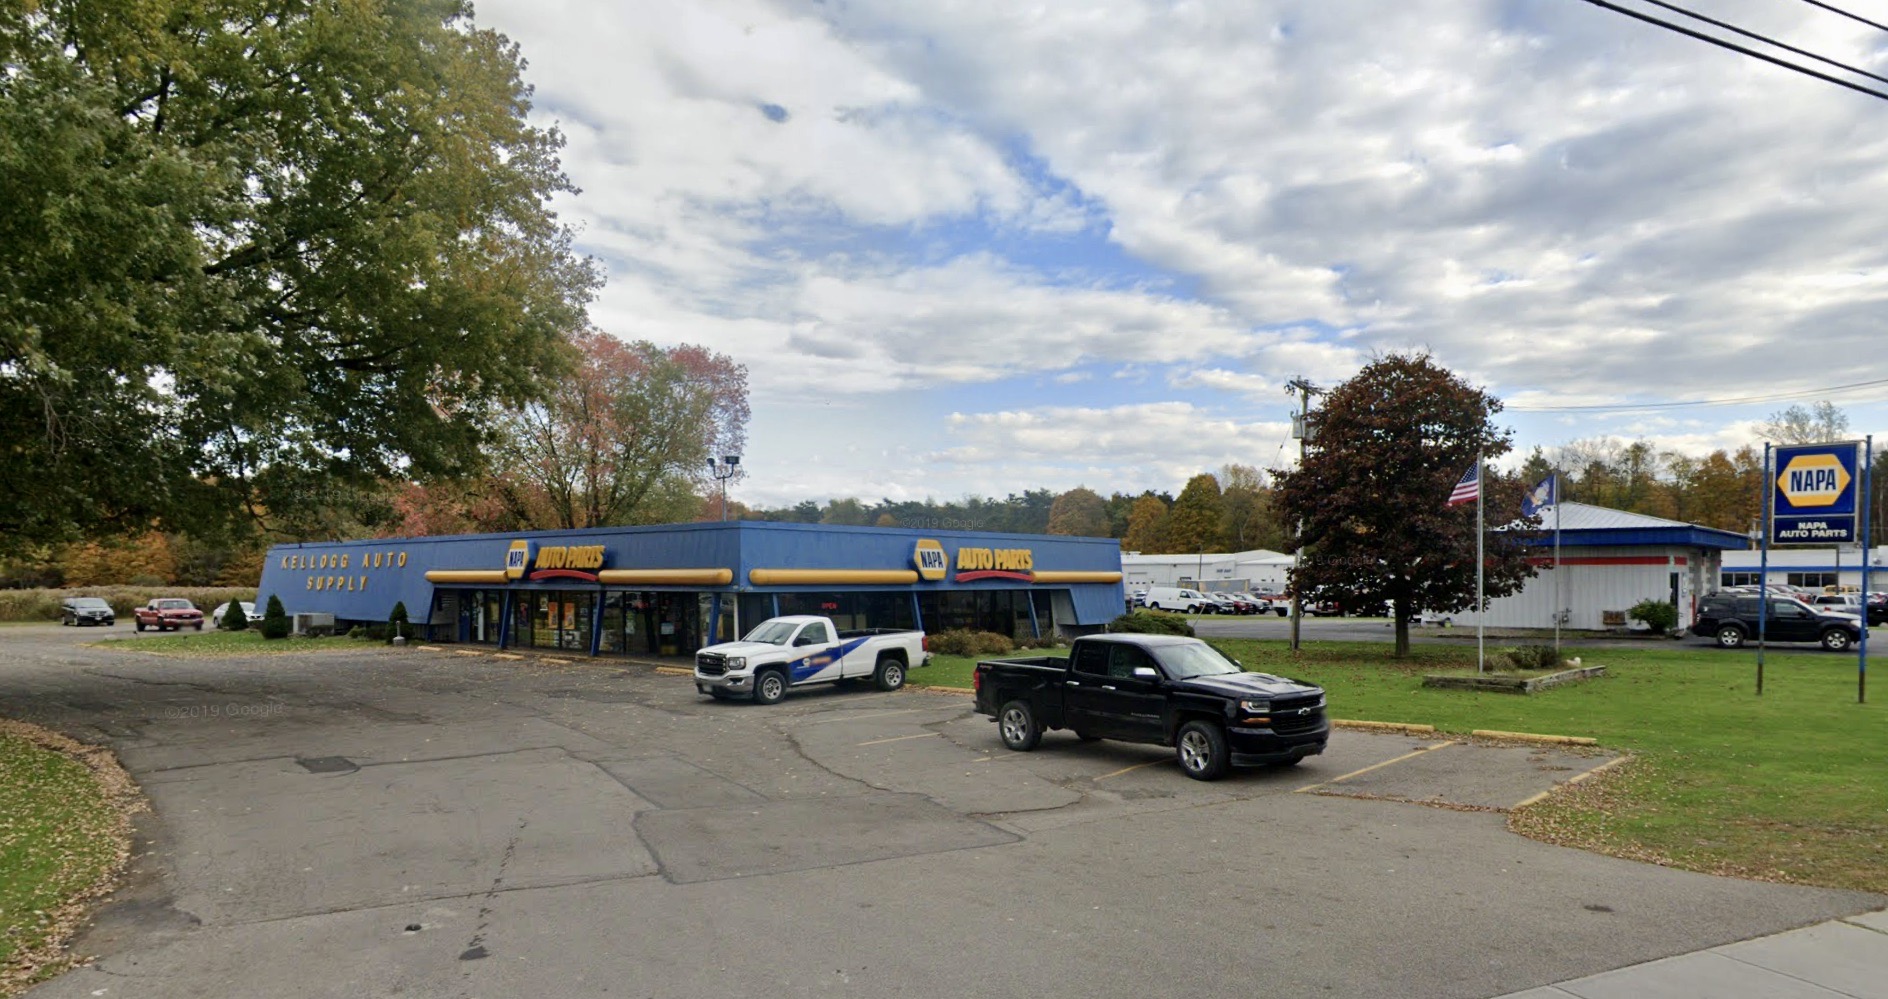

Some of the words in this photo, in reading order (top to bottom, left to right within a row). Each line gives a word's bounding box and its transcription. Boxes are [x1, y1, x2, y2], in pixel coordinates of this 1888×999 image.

[1791, 469, 1837, 492] NAPA
[1779, 530, 1809, 538] AUTO
[1811, 529, 1848, 538] PARTS
[1798, 521, 1828, 530] NAPA
[281, 553, 348, 570] KELLOGG
[362, 551, 408, 568] AUTO
[508, 551, 525, 568] NAPA
[534, 546, 568, 569] AUTO
[565, 545, 606, 569] PARTS
[920, 550, 944, 568] NAPA
[957, 547, 994, 570] AUTO
[993, 548, 1034, 570] PARTS
[306, 575, 368, 591] SUPPLY
